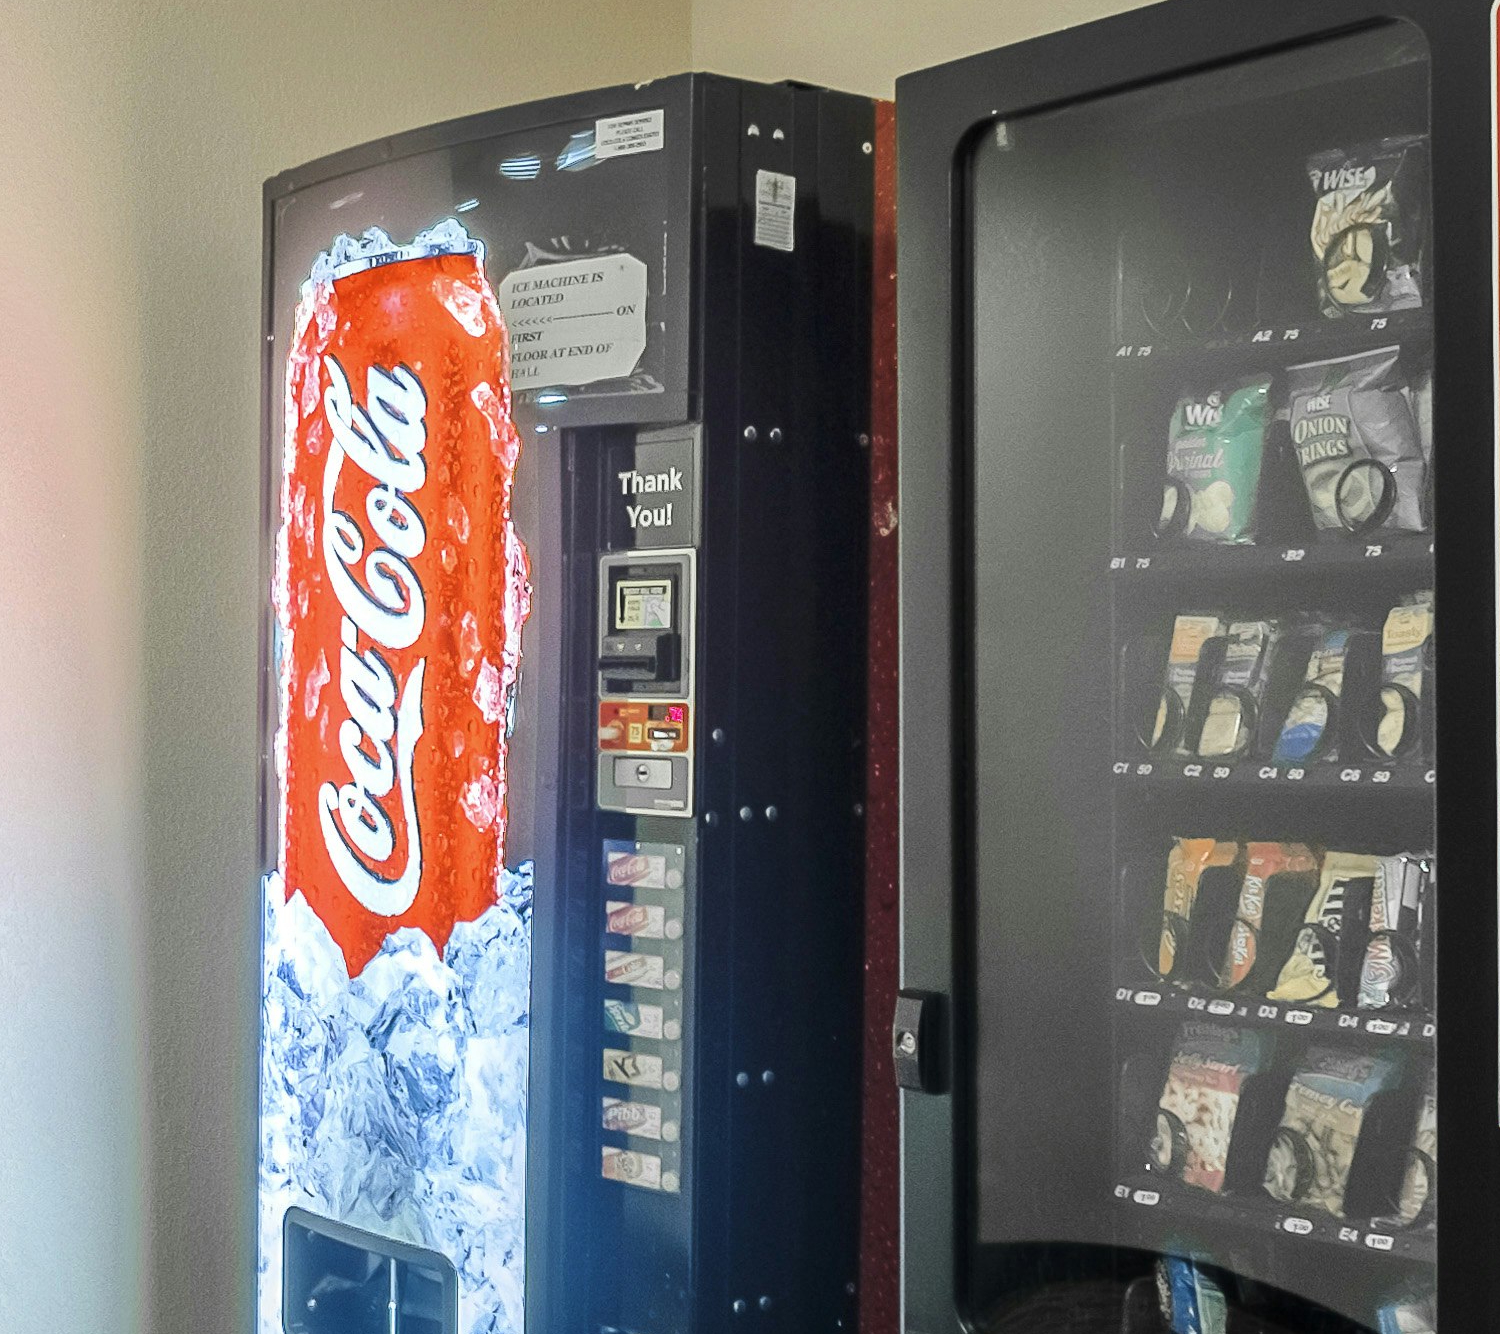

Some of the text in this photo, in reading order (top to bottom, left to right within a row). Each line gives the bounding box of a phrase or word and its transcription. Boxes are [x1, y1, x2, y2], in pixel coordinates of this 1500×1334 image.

[512, 271, 605, 294] ICE MACHINE IS
[511, 293, 564, 309] LOCATED
[616, 305, 637, 317] ON
[511, 331, 545, 344] FIRST
[1252, 329, 1273, 343] A2
[511, 342, 615, 364] FLOOR AT END OF
[1116, 345, 1133, 357] A1
[511, 367, 540, 379] HALL
[1294, 417, 1348, 444] ONION
[1302, 439, 1348, 466] RINGS
[618, 467, 683, 495] Thank
[626, 503, 673, 529] You!
[1364, 545, 1383, 557] 75
[319, 352, 428, 918] Coca-Cola
[1112, 762, 1129, 774] C1
[1136, 764, 1153, 775] 50
[1183, 764, 1203, 777] C2
[1213, 766, 1230, 778] 50
[1258, 767, 1278, 779] C4
[1424, 770, 1436, 783] C
[1115, 987, 1133, 1001] D1
[1187, 996, 1206, 1010] D2
[1257, 1005, 1278, 1019] D3
[1338, 1014, 1359, 1028] D4
[1422, 1024, 1436, 1037] D
[607, 1106, 640, 1122] Pibb
[1339, 1226, 1358, 1242] E4
